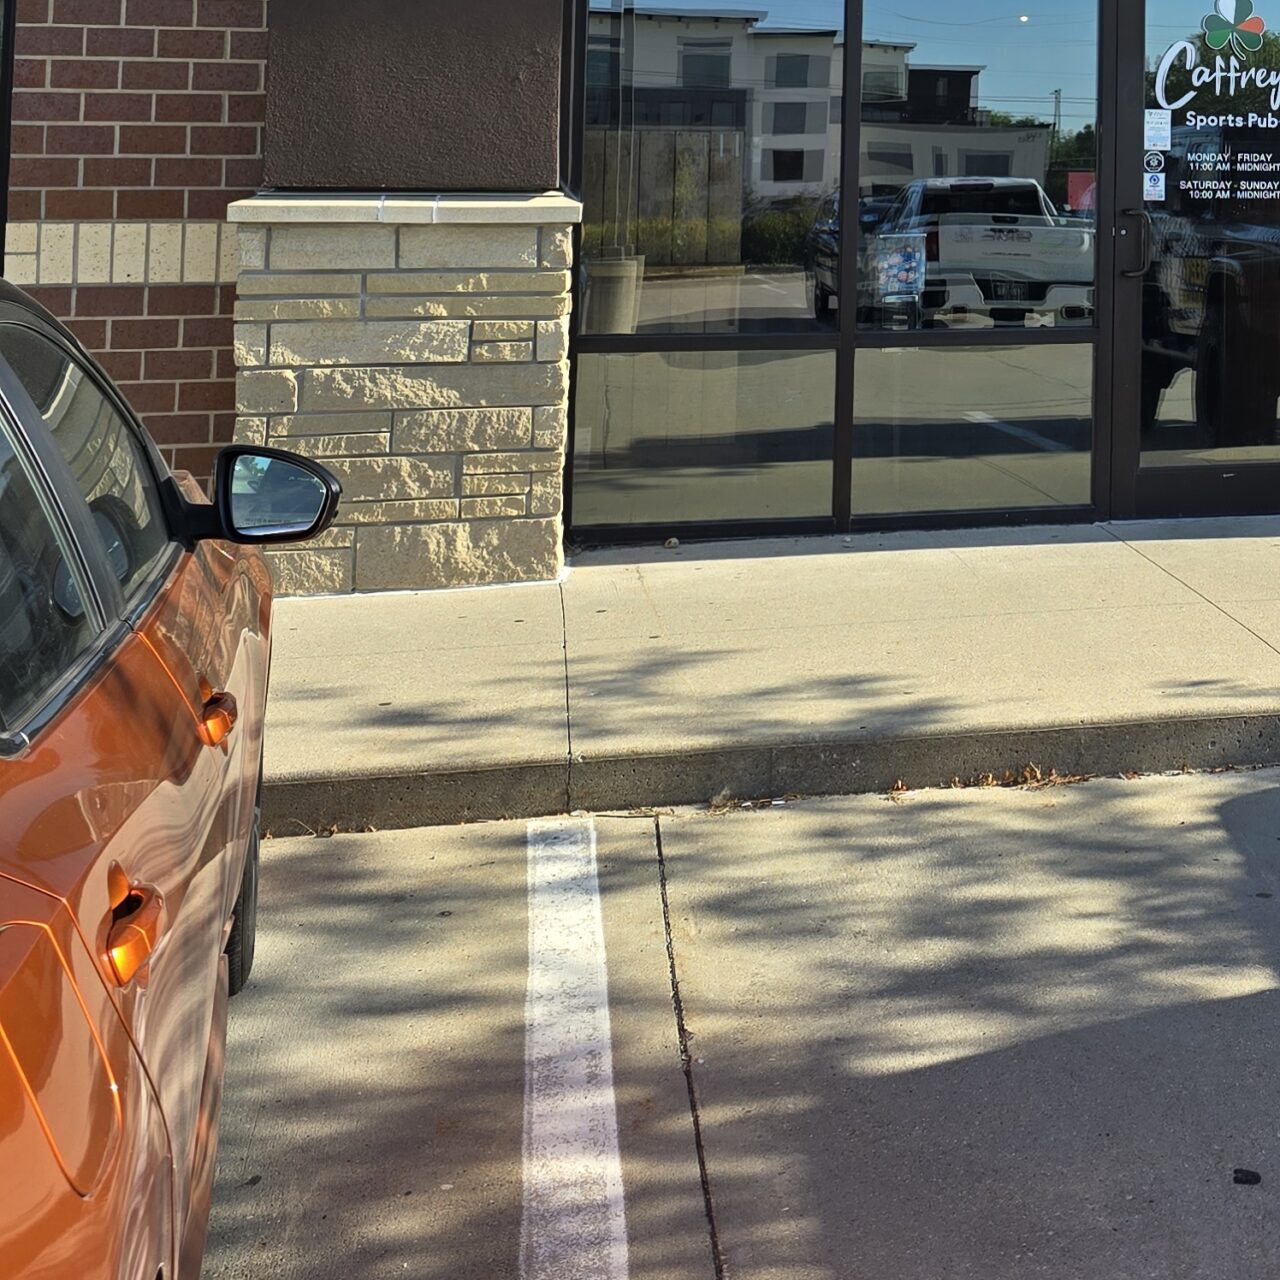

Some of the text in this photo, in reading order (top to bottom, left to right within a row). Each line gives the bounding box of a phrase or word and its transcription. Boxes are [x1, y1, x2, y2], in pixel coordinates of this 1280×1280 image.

[1185, 110, 1243, 130] Sports
[1247, 113, 1279, 129] Pub
[1187, 152, 1230, 162] MONDAY
[1237, 153, 1273, 162] FRIDAY
[1189, 162, 1213, 171] 11:00
[1215, 162, 1231, 171] AM
[1179, 180, 1232, 190] SATURDAY
[1239, 180, 1280, 190] SUNDAY
[1189, 190, 1213, 199] 10:00
[1215, 190, 1231, 199] AM
